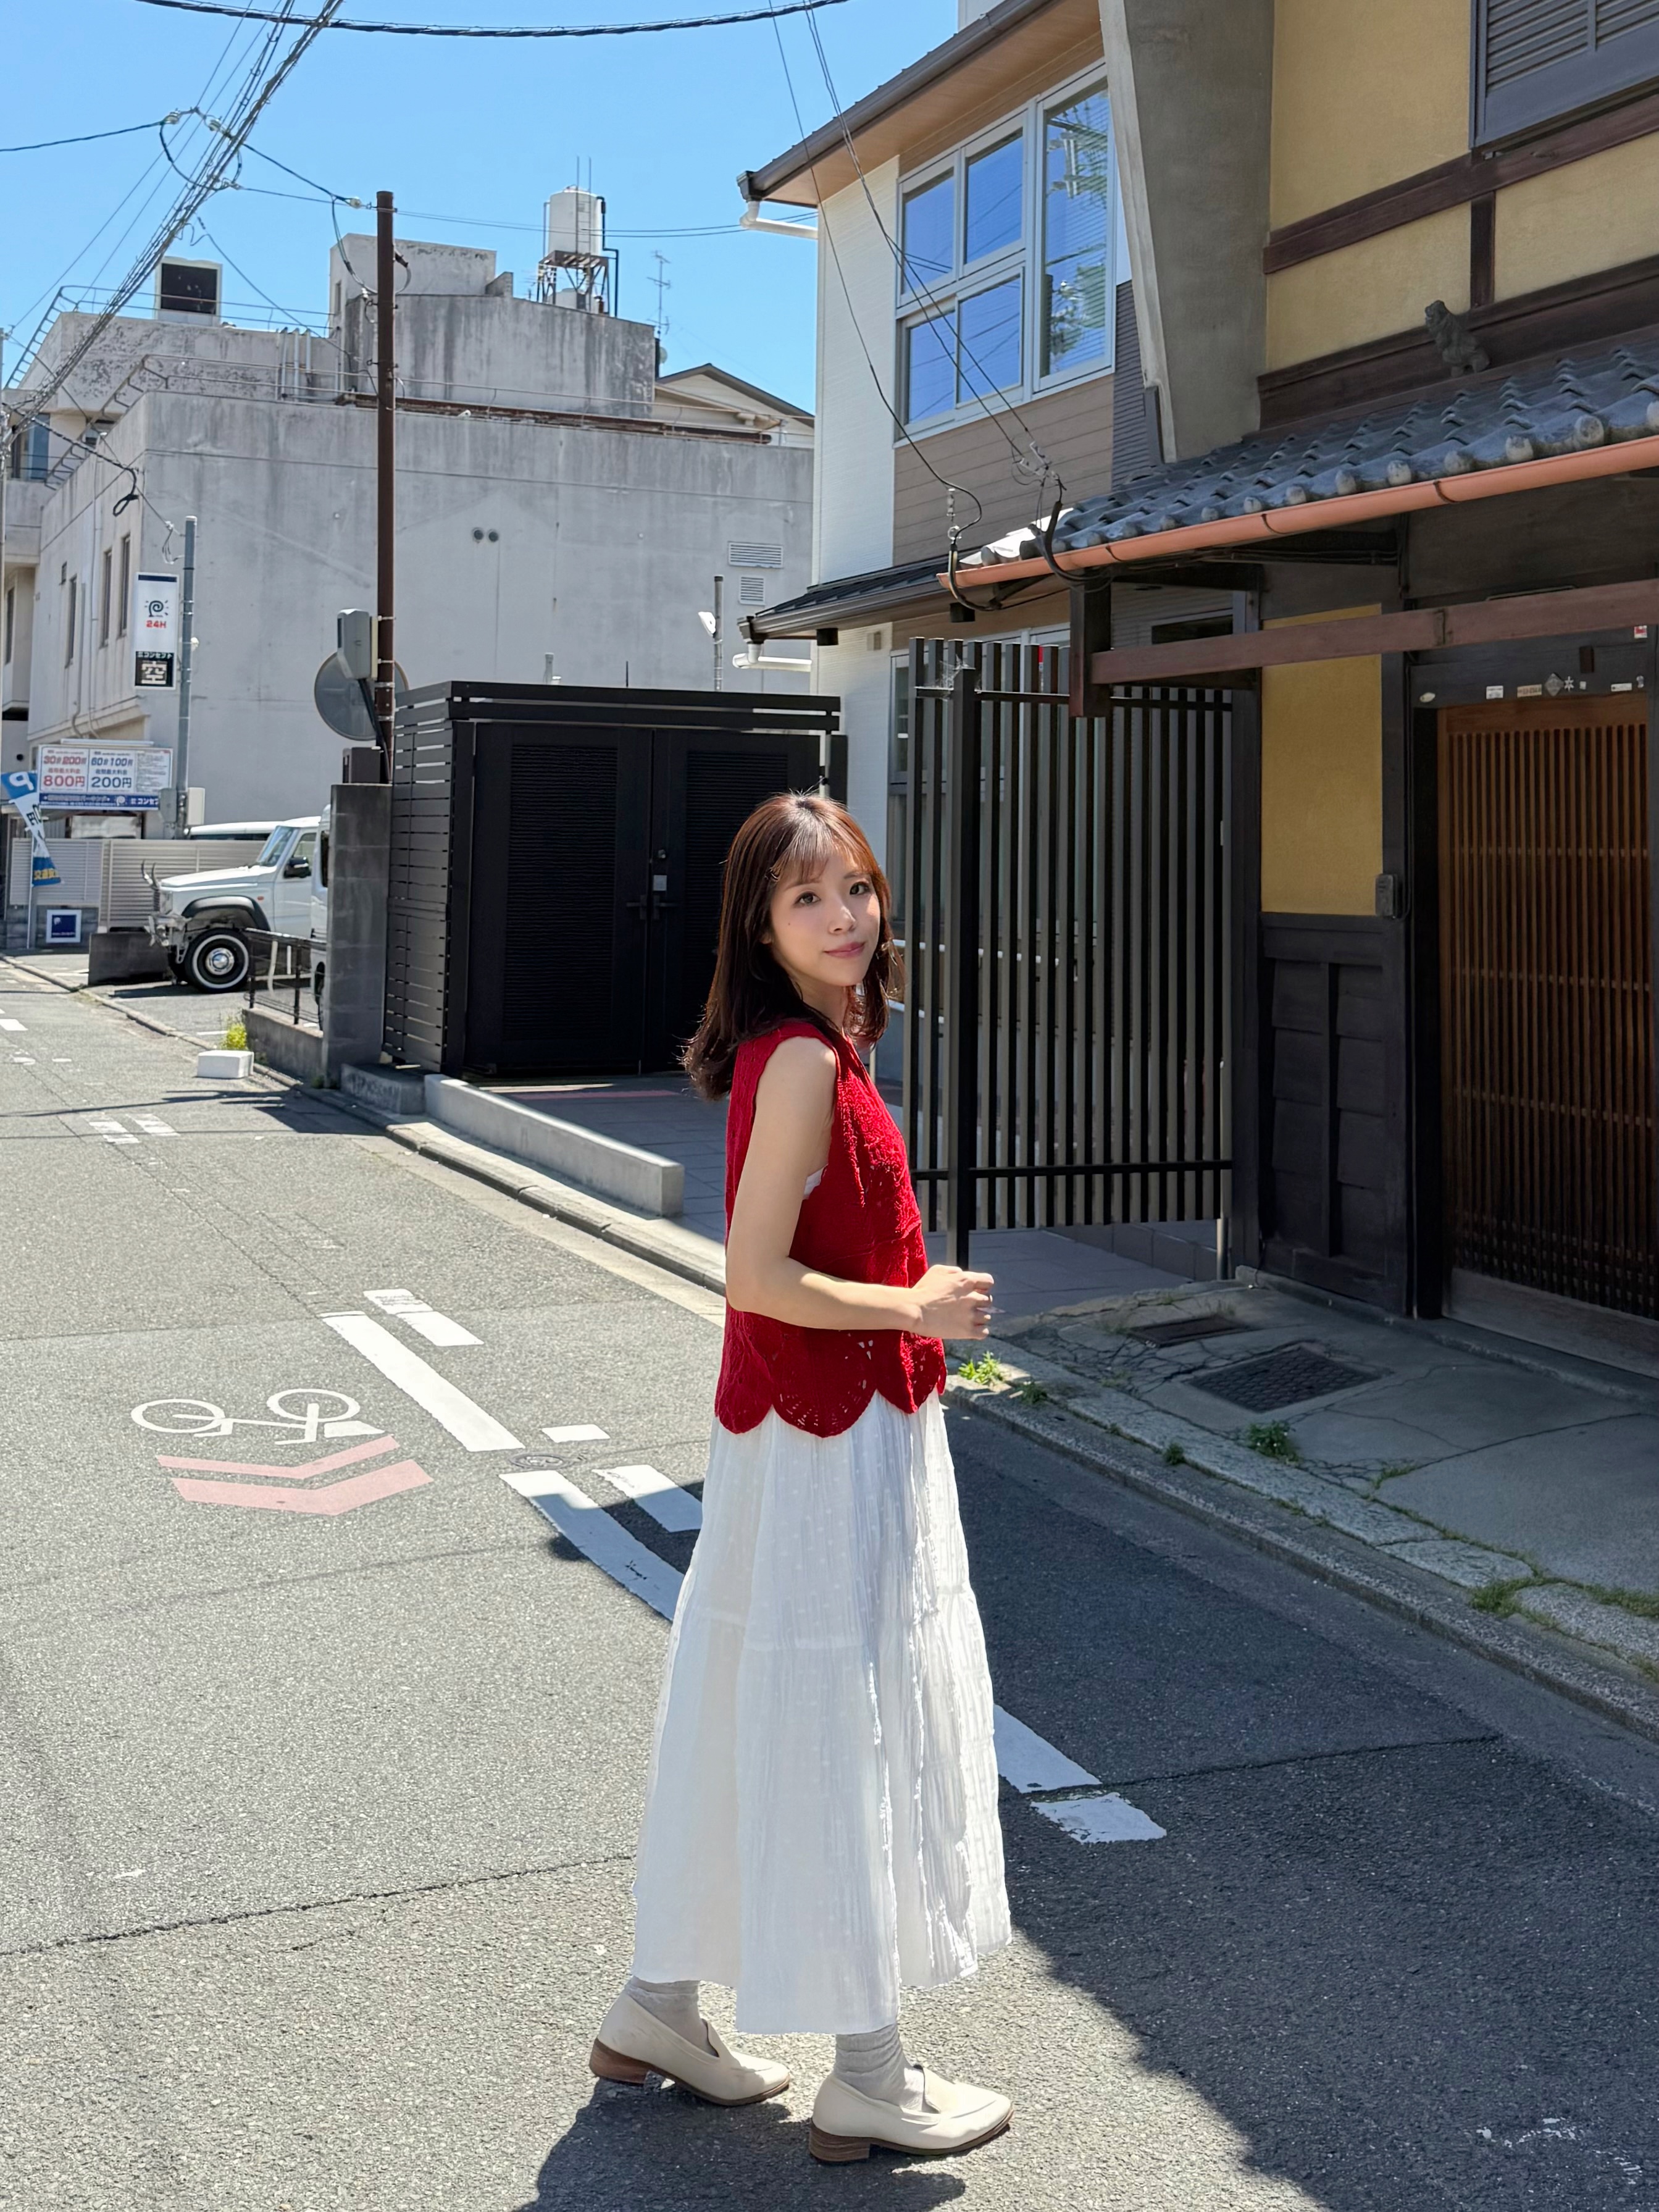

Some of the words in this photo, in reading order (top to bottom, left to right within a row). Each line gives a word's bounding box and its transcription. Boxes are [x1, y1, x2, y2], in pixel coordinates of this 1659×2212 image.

[146, 620, 167, 628] 24H
[141, 660, 167, 684] 空
[43, 775, 85, 787] 800円
[91, 776, 132, 788] 200円
